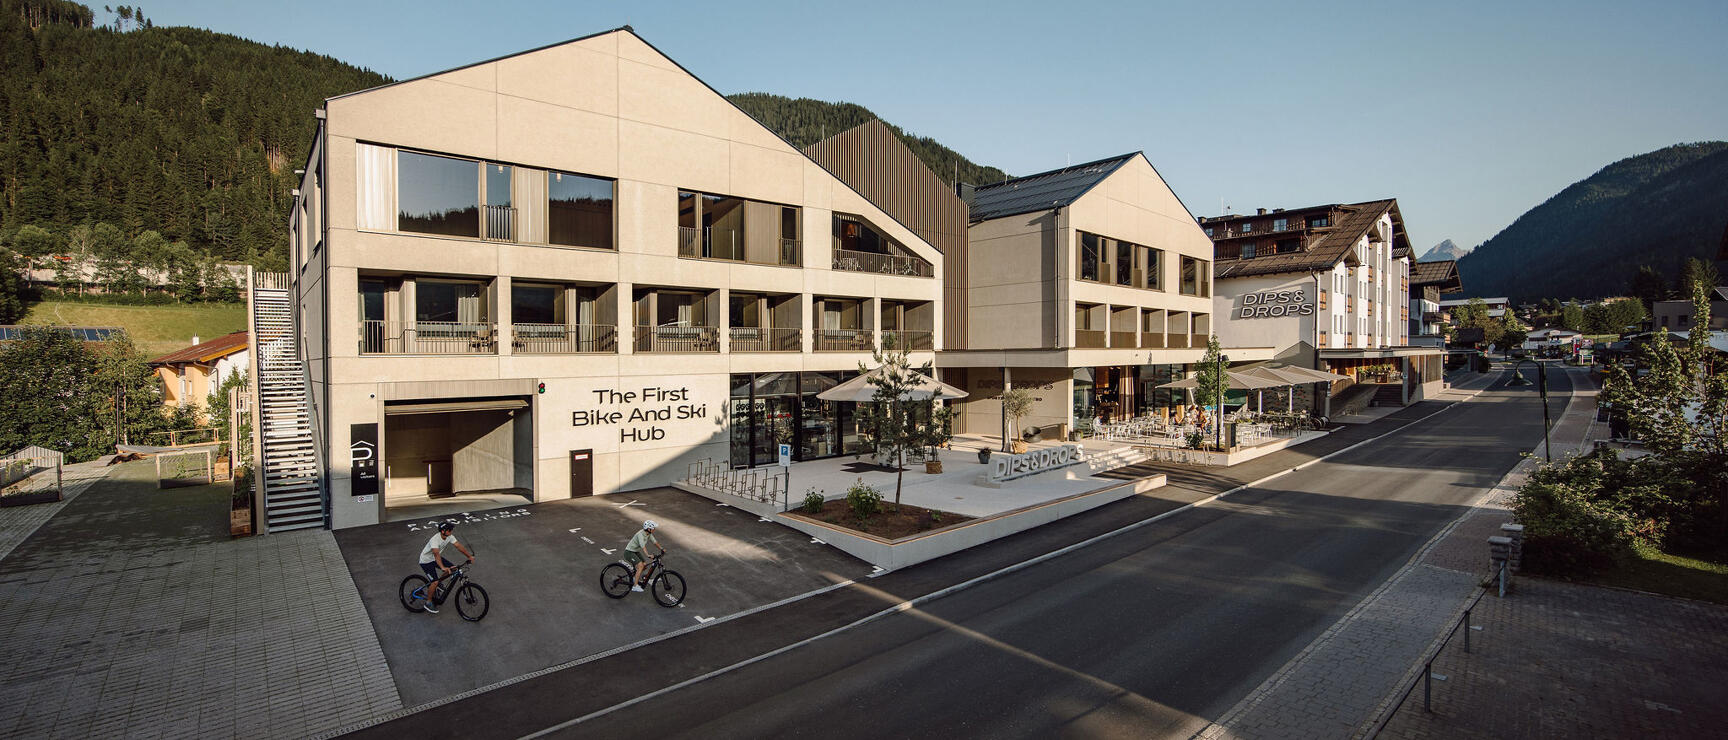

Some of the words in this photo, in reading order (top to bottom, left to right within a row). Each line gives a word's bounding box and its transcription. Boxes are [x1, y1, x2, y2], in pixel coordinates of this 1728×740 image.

[1243, 290, 1291, 305] DIPS
[1293, 289, 1305, 303] &
[1240, 303, 1314, 318] DROPS
[592, 389, 637, 405] The
[642, 387, 689, 402] First
[572, 409, 623, 427] Bike
[627, 405, 671, 423] And
[676, 404, 707, 420] Ski
[620, 426, 665, 443] Hub
